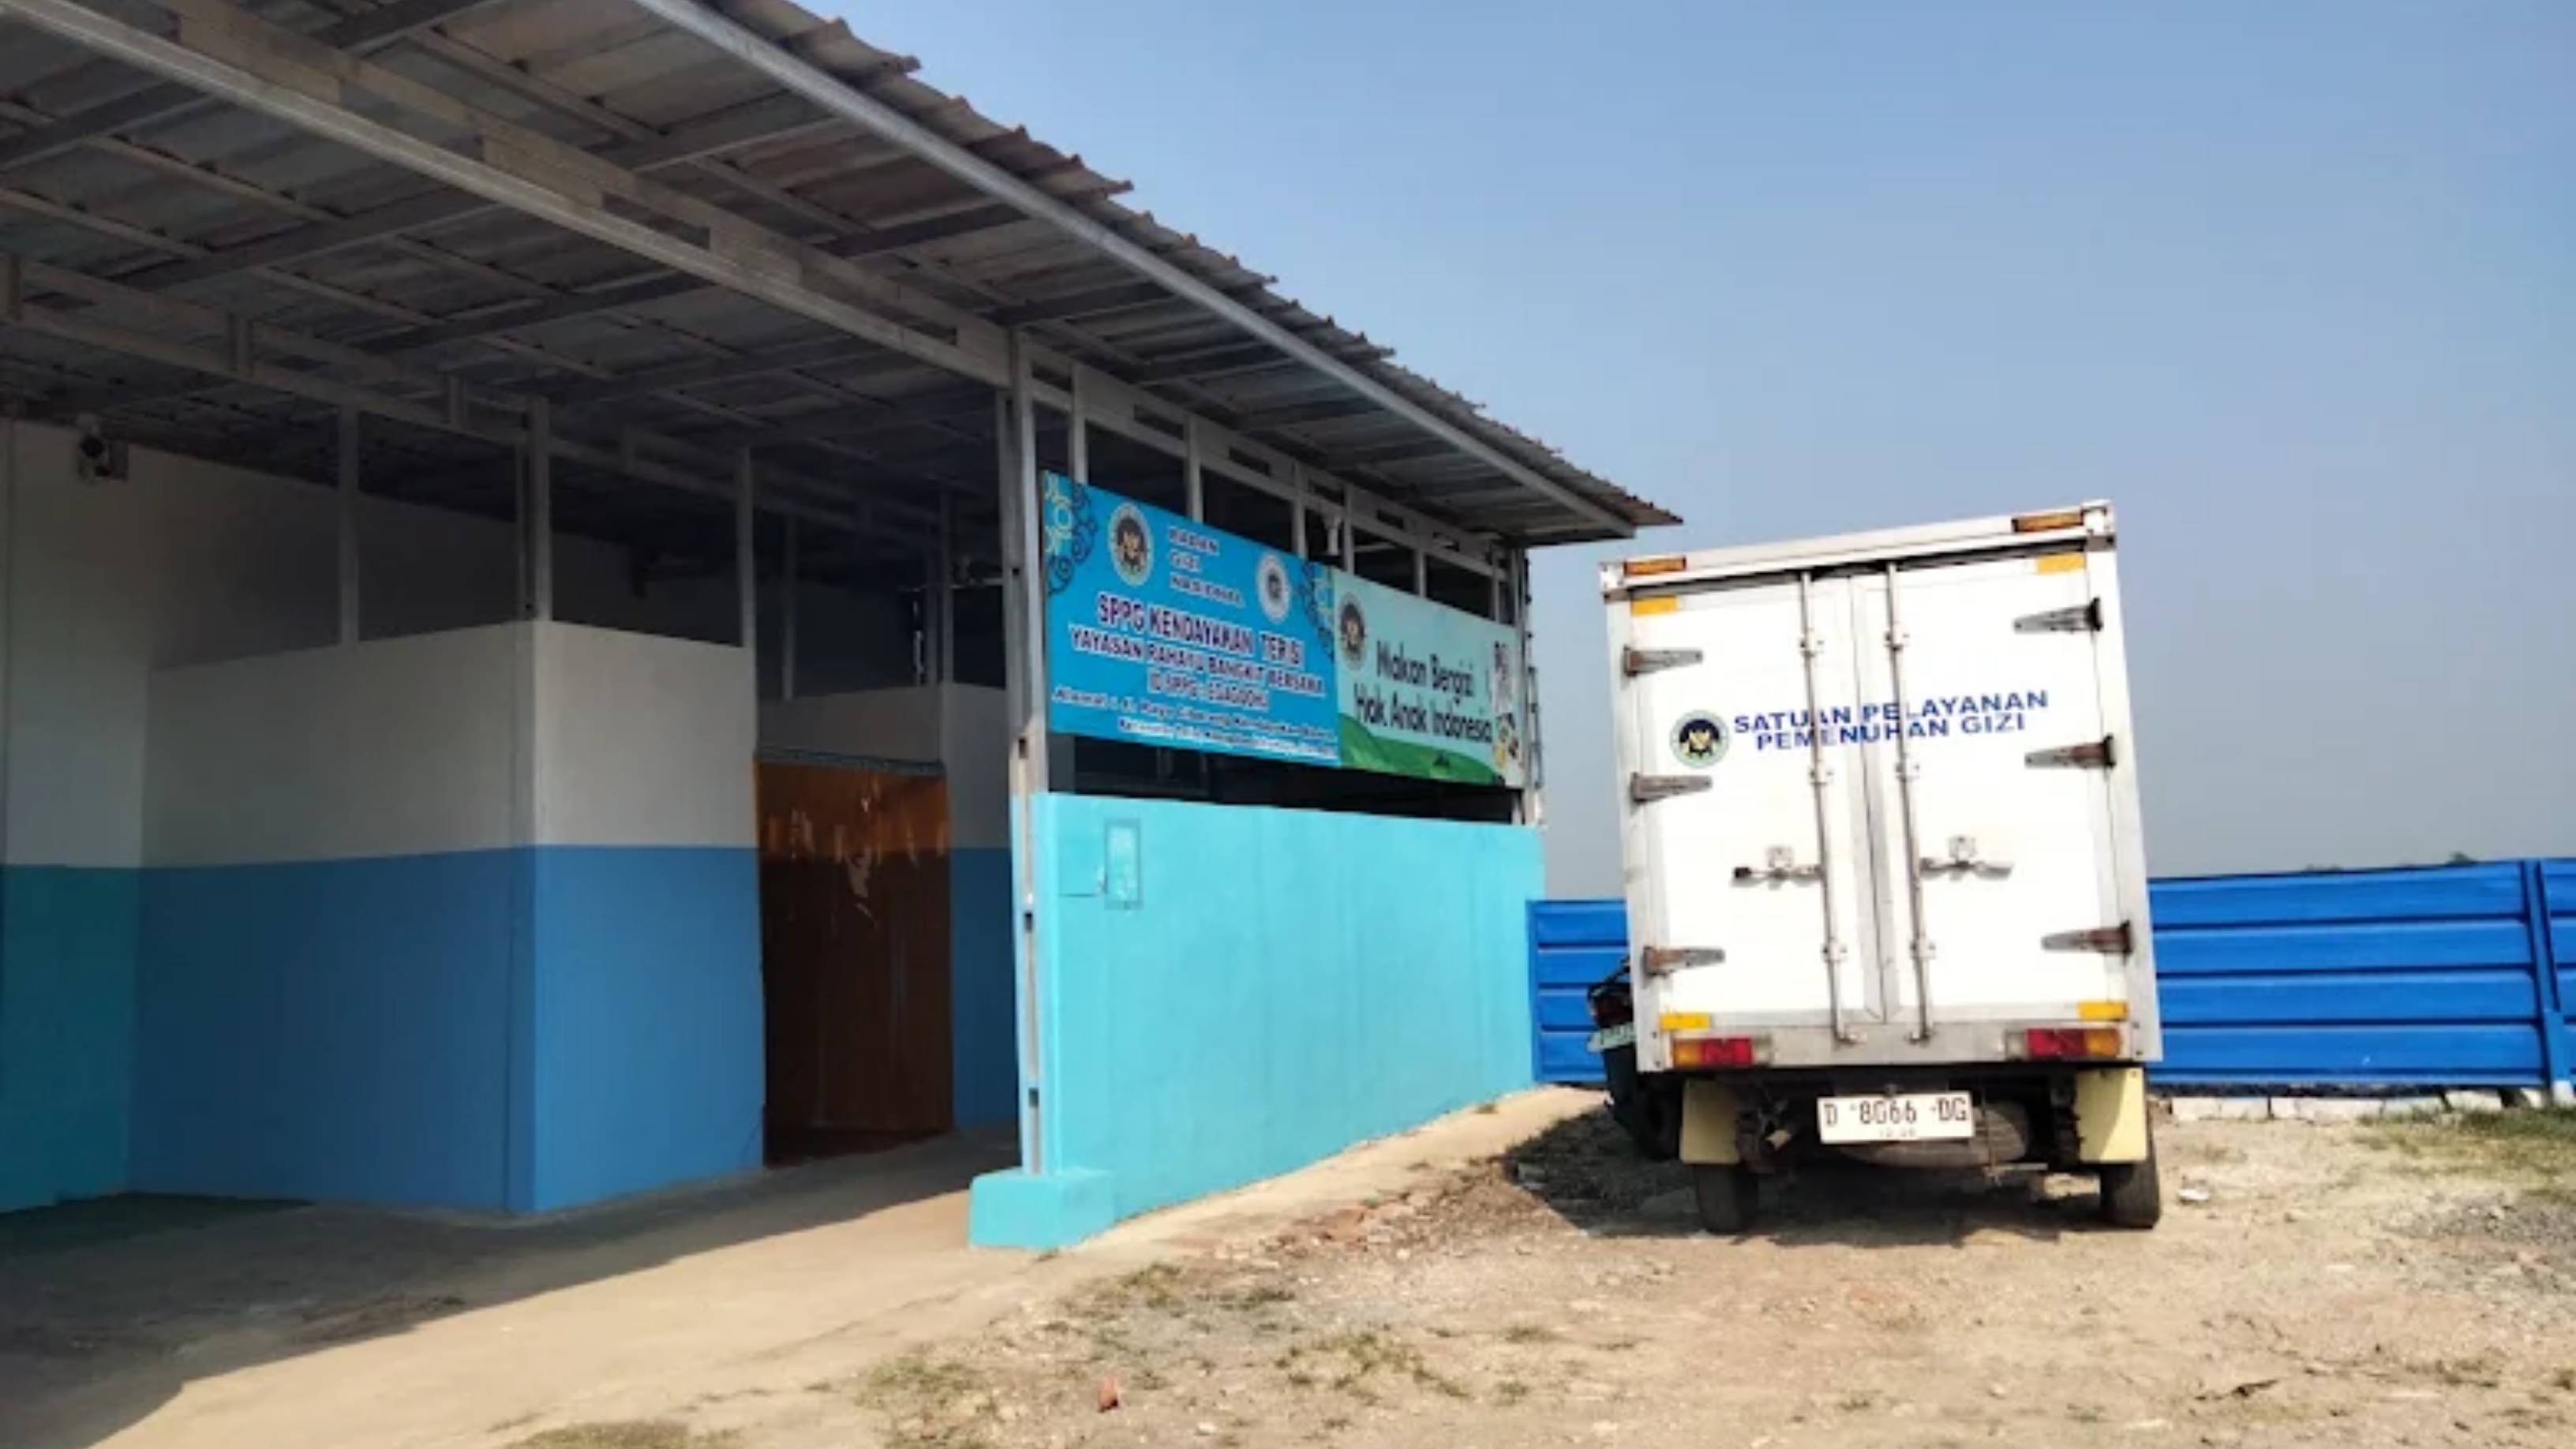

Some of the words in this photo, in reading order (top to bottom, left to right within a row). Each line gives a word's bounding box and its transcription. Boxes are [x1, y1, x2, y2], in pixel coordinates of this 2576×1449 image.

[1098, 592, 1144, 634] SPPG
[1148, 605, 1254, 657] KENDAYAKAN
[1069, 623, 1144, 663] YAYASAN
[1147, 641, 1205, 673] RAHAYU
[1208, 654, 1265, 682] BANGKIT
[1267, 667, 1326, 698] BERSAMA
[1376, 640, 1425, 687] Makan
[1429, 653, 1474, 706] Bergizi
[1354, 682, 1387, 727] Hak
[1391, 690, 1427, 733] Anak
[1430, 698, 1493, 744] Indonesia
[1735, 707, 1851, 734] SATUAN
[1863, 691, 2048, 722] PELAYANAN
[1757, 719, 1949, 751] PEMENUHAN
[1961, 713, 2025, 734] GIZI
[1824, 1103, 1838, 1126] D
[1859, 1099, 1917, 1125] 8066
[1938, 1097, 1967, 1121] DG
